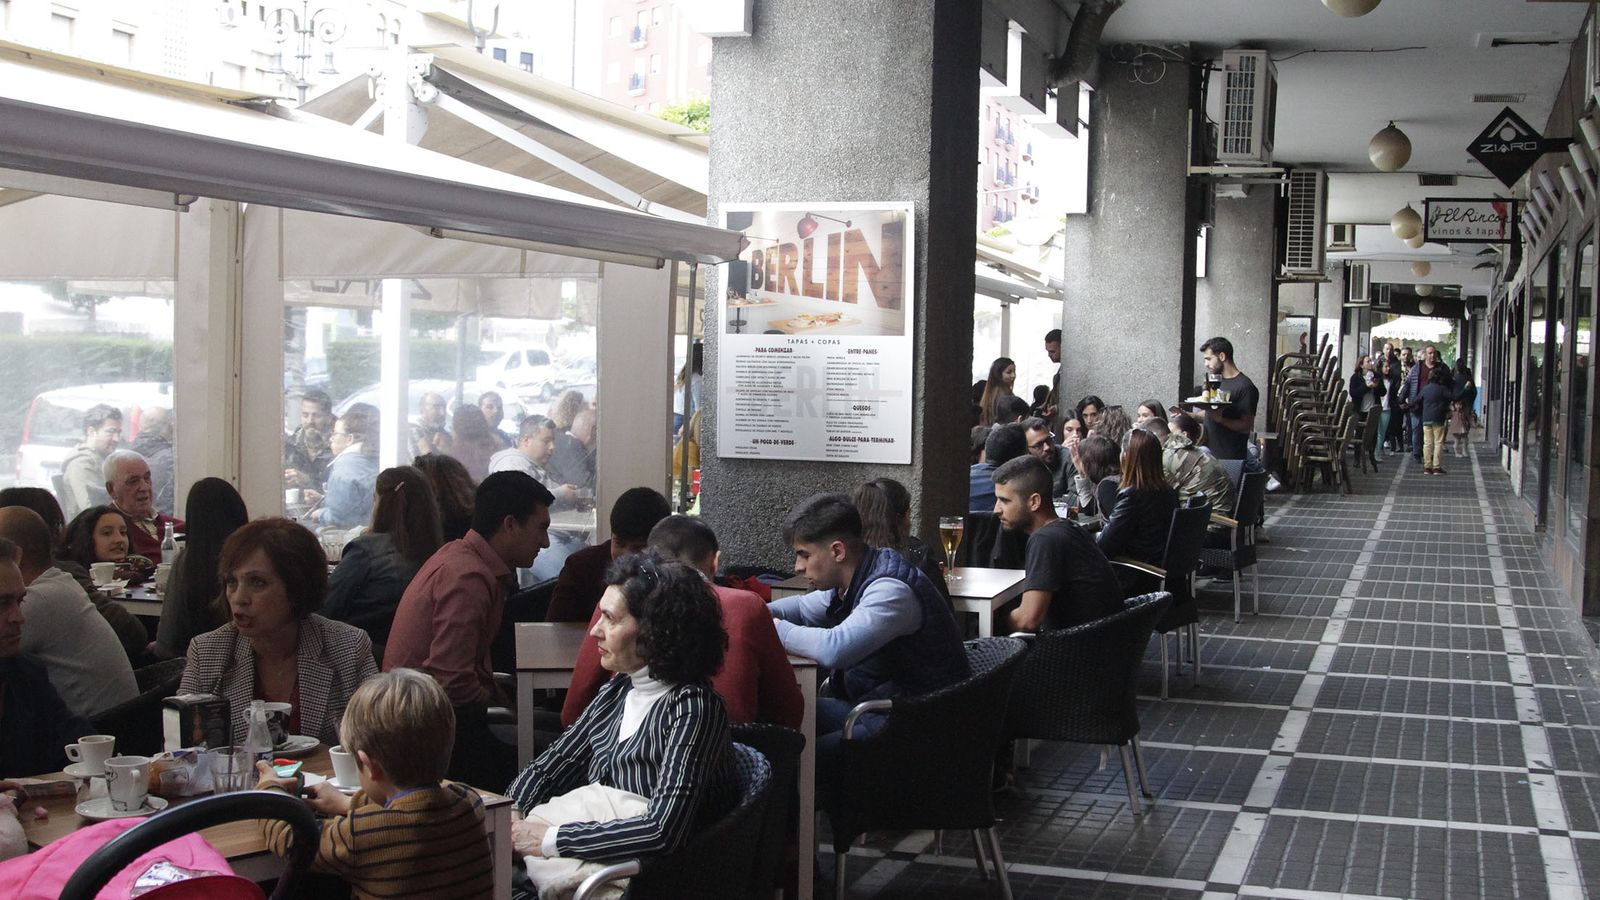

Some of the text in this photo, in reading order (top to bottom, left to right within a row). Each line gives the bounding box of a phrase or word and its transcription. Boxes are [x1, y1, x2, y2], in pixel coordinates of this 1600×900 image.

[1480, 141, 1537, 153] ZIARO
[1464, 227, 1472, 235] &
[750, 222, 904, 311] BERLIN
